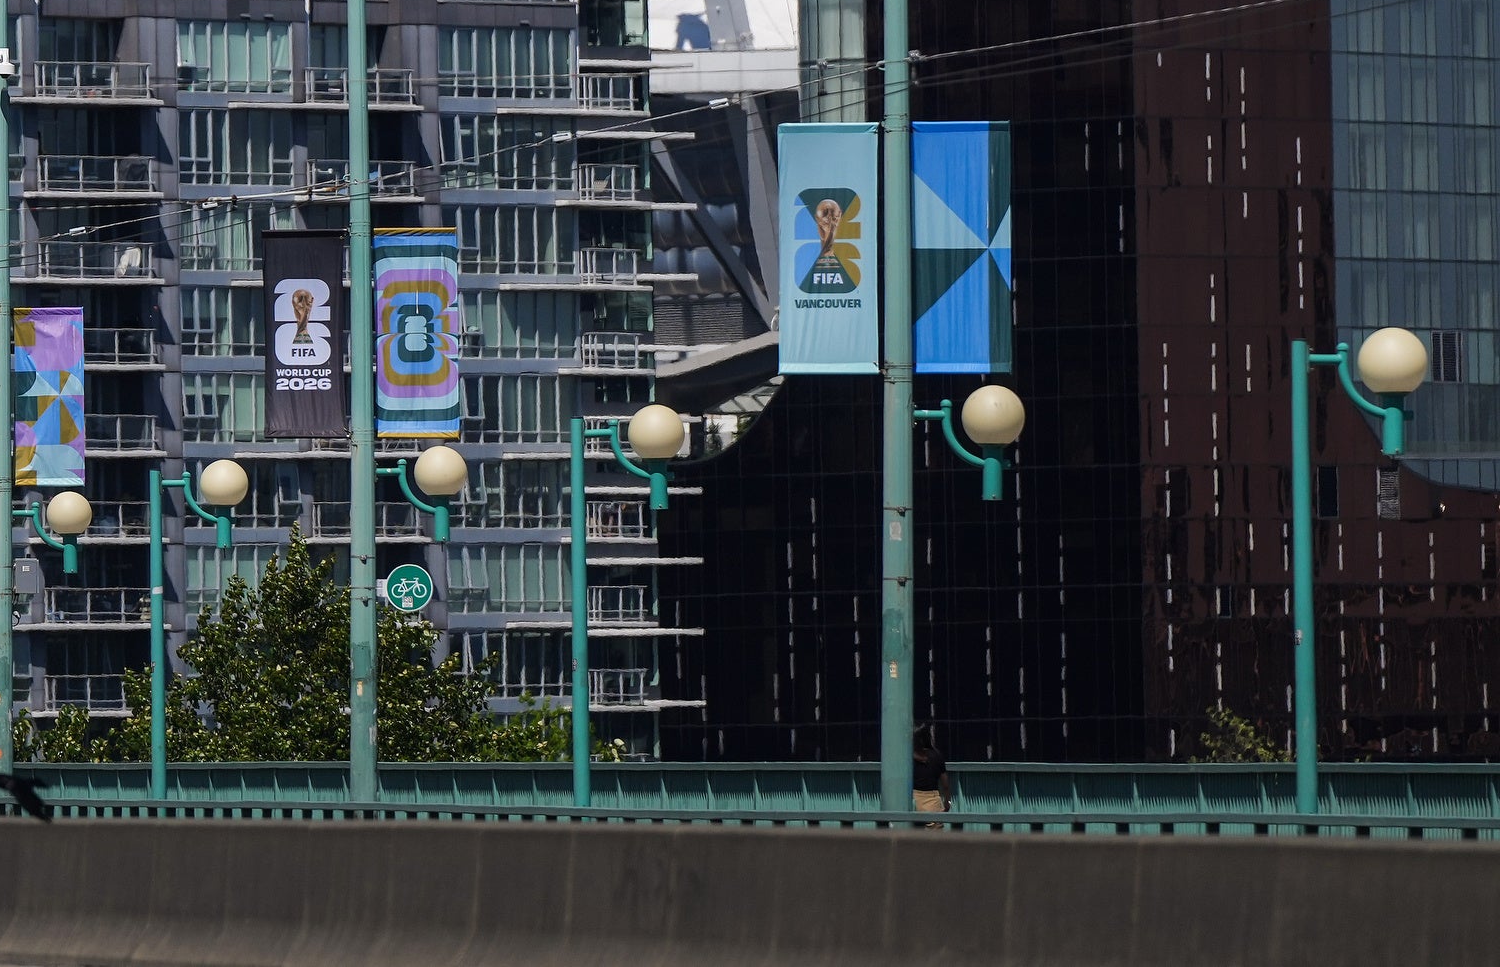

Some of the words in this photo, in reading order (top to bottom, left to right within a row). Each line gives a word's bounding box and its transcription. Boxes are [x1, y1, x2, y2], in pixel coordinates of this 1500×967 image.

[813, 272, 844, 284] FIFA
[794, 298, 862, 309] VANCOUVER
[291, 348, 316, 358] FIFA
[276, 368, 311, 377] WORLD
[312, 368, 332, 377] CUP
[275, 378, 332, 391] 2026
